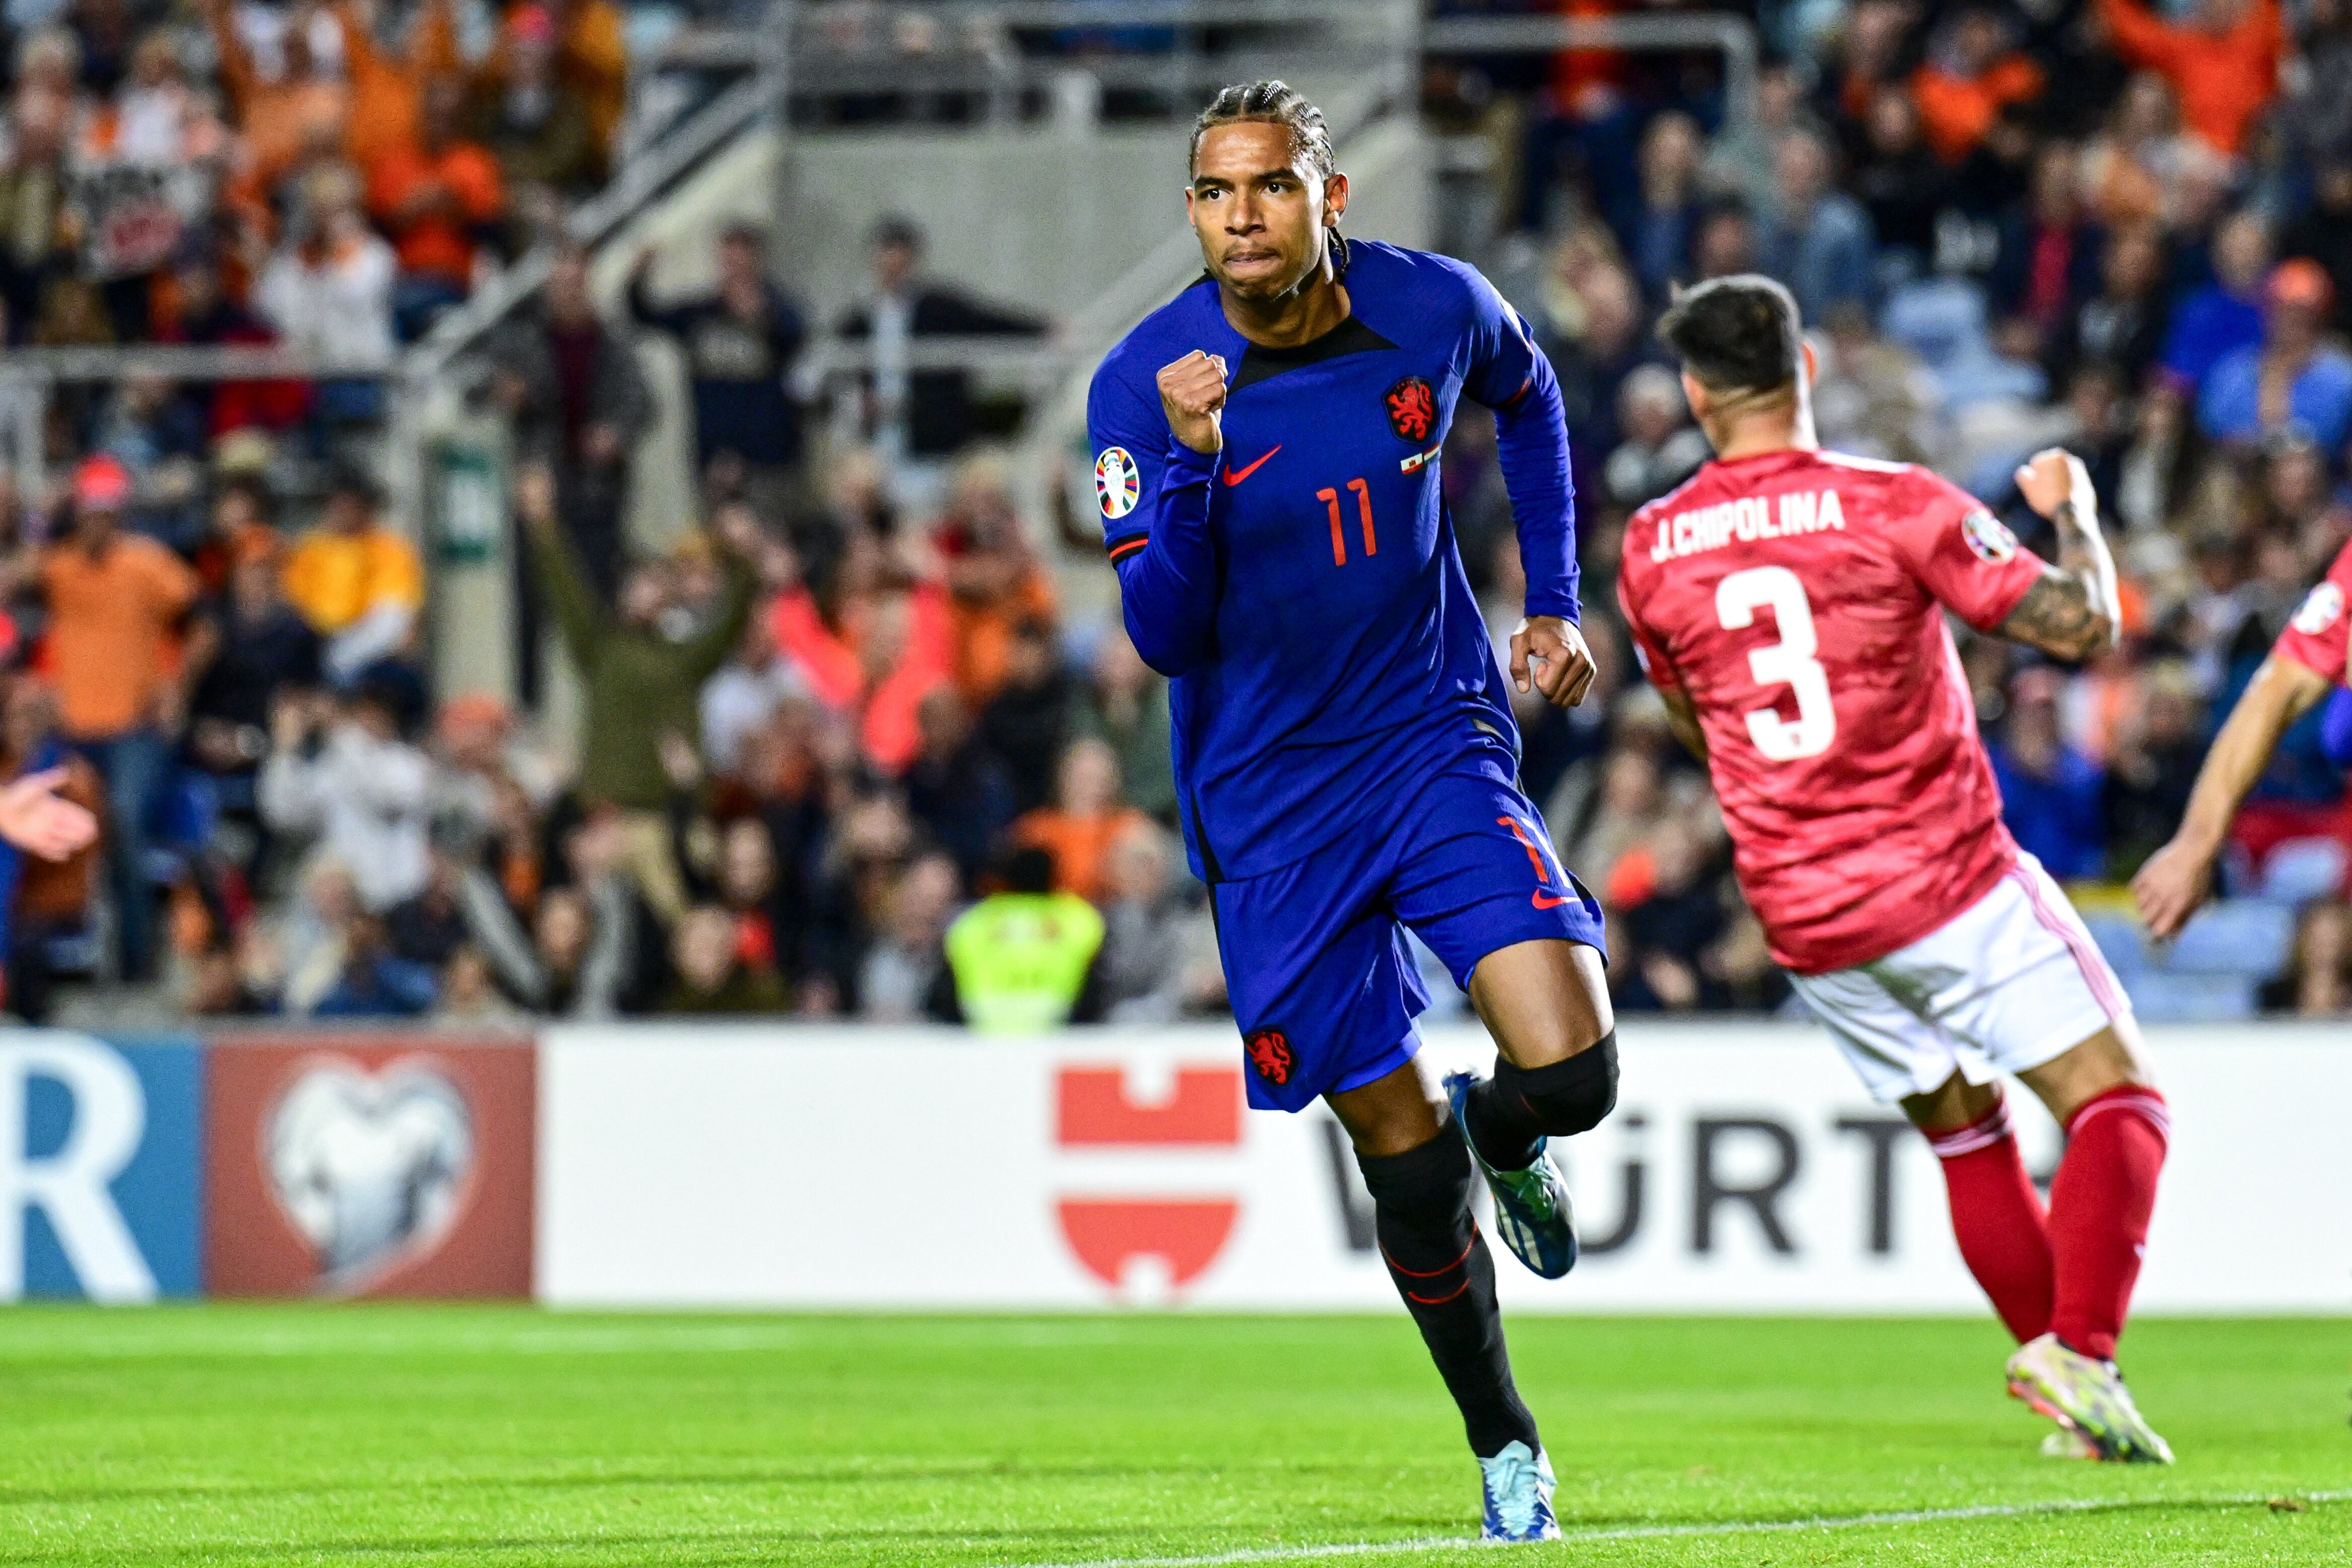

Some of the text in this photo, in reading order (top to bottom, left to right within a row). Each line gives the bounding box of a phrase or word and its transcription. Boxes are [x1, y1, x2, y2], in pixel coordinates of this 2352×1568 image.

[1316, 477, 1377, 567] 11
[1649, 488, 1846, 563] J.CHIPOLINA
[1715, 565, 1837, 762] 3
[1495, 816, 1572, 890] 11
[1318, 1111, 2068, 1255] ÜRT
